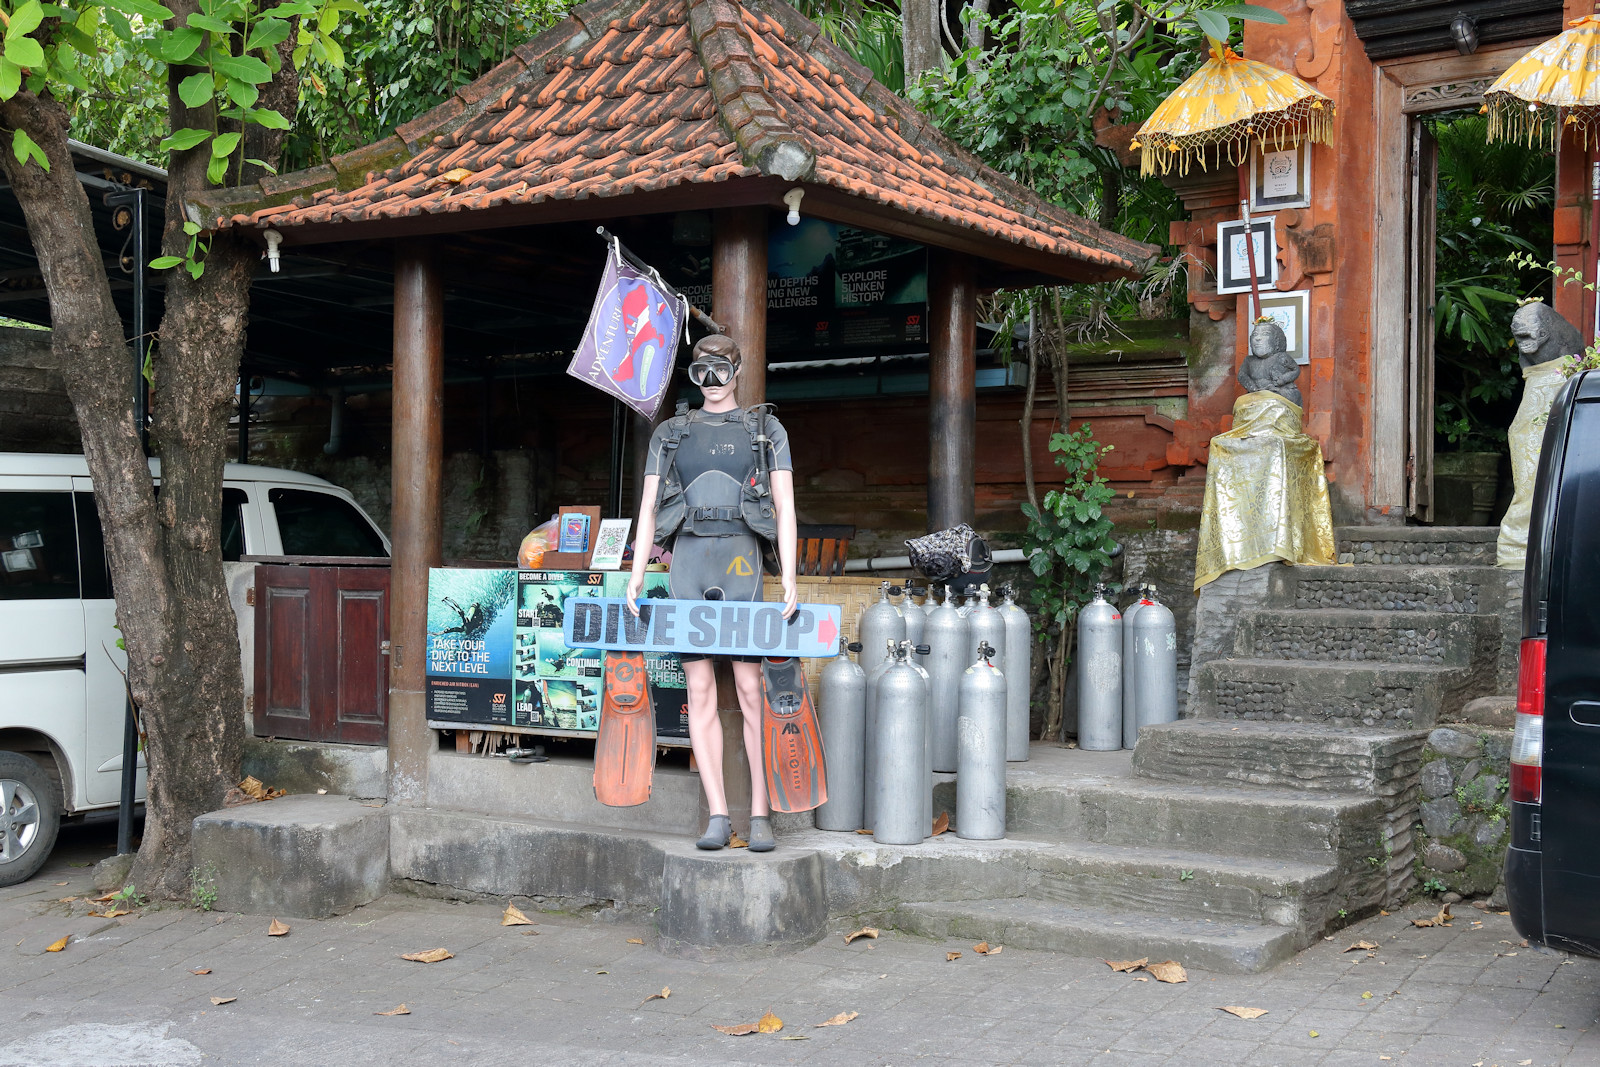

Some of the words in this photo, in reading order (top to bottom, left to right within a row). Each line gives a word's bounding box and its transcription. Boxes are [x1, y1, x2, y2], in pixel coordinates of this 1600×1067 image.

[780, 275, 818, 286] DEPTHS
[841, 270, 888, 282] EXPLORE
[675, 285, 712, 295] ISCOVE
[787, 286, 810, 297] NEW
[841, 281, 885, 292] SUNKEN
[841, 291, 885, 303] HISTORY
[519, 573, 542, 581] BECOME
[542, 573, 547, 581] A
[547, 573, 564, 581] DIVER
[587, 574, 602, 584] SSI
[518, 609, 538, 618] START
[572, 602, 677, 646] DIVE
[688, 605, 815, 651] SHOP
[432, 639, 457, 650] TAKE
[458, 640, 485, 651] YOUR
[432, 650, 455, 661] DIVE
[457, 651, 469, 662] TO
[470, 652, 490, 663] THE
[431, 662, 457, 672] NEXT
[459, 663, 488, 674] LEVEL
[566, 658, 600, 668] CONTINUE
[655, 671, 685, 683] HERE
[492, 693, 507, 704] SSI
[516, 703, 533, 712] LEAD
